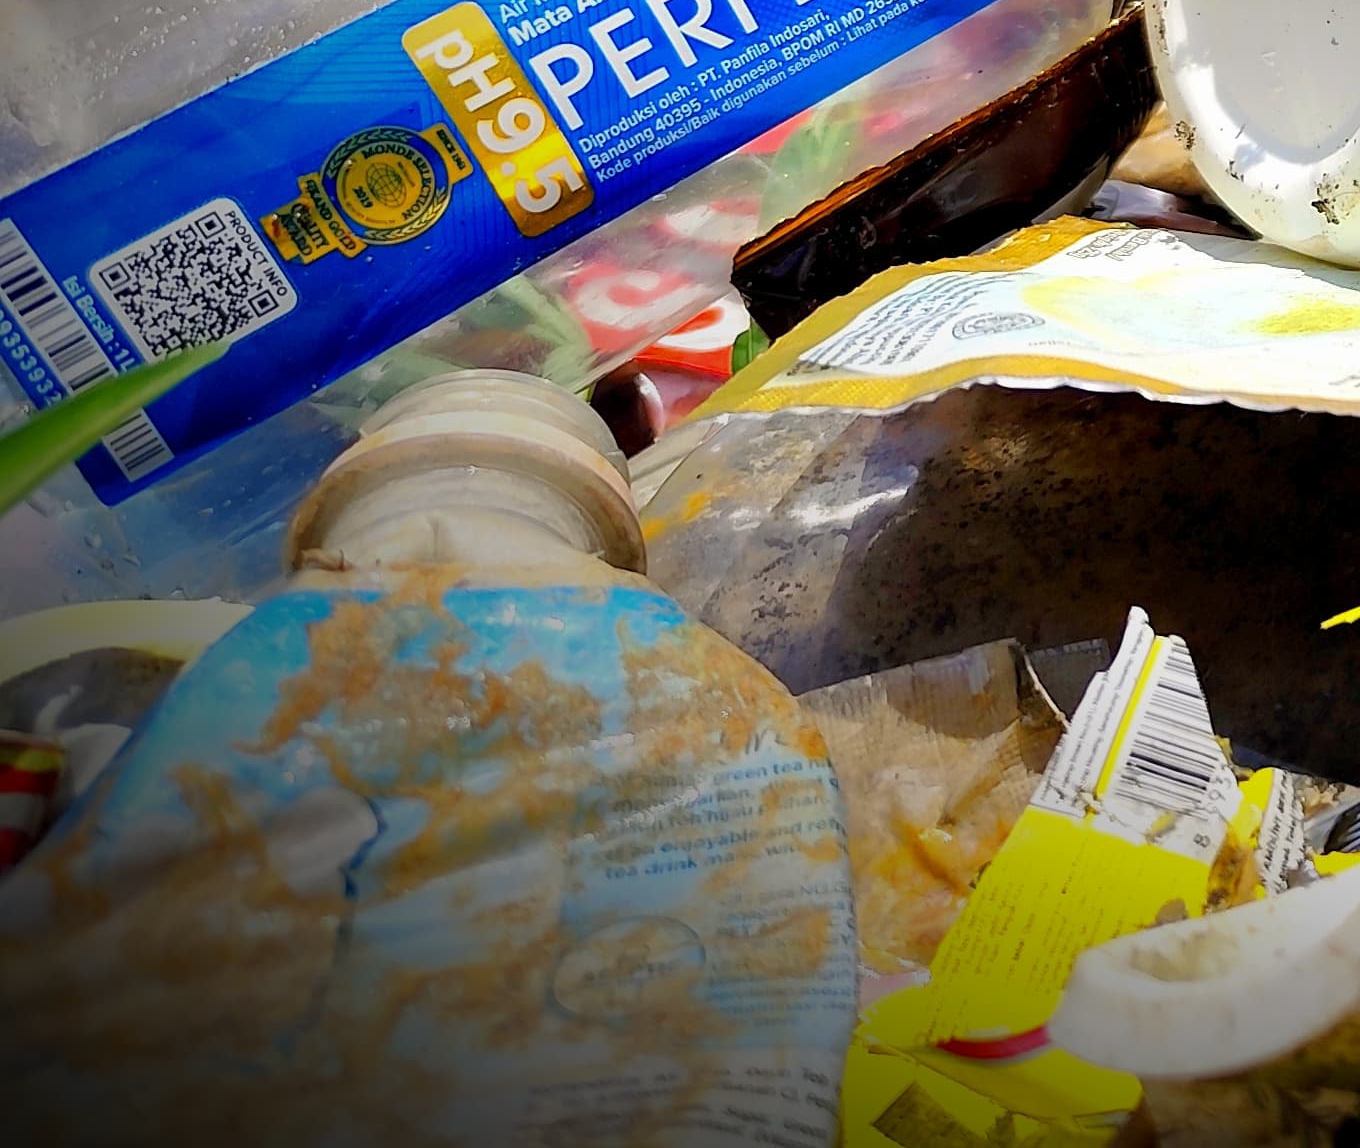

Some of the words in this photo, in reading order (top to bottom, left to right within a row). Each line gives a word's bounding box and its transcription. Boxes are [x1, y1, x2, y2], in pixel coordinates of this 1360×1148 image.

[508, 0, 574, 46] Mata
[577, 98, 662, 154] Diproduksi
[657, 81, 692, 110] oleh
[696, 64, 723, 88] PT.
[718, 37, 771, 76] Panfila
[766, 5, 832, 51] Indosari,
[586, 123, 656, 171] Bandung
[652, 97, 703, 133] 40395
[707, 51, 785, 102] Indonesia,
[779, 28, 827, 63] BPOM
[838, 5, 867, 30] MD
[594, 153, 634, 184] Kode
[628, 103, 724, 165] produksi/Baik
[717, 66, 790, 116] digunakan
[784, 36, 842, 77] sebelum
[843, 15, 878, 43] Lihat
[415, 27, 586, 216] pH9.5
[225, 210, 268, 267] PRODUCT
[262, 265, 289, 299] INFO
